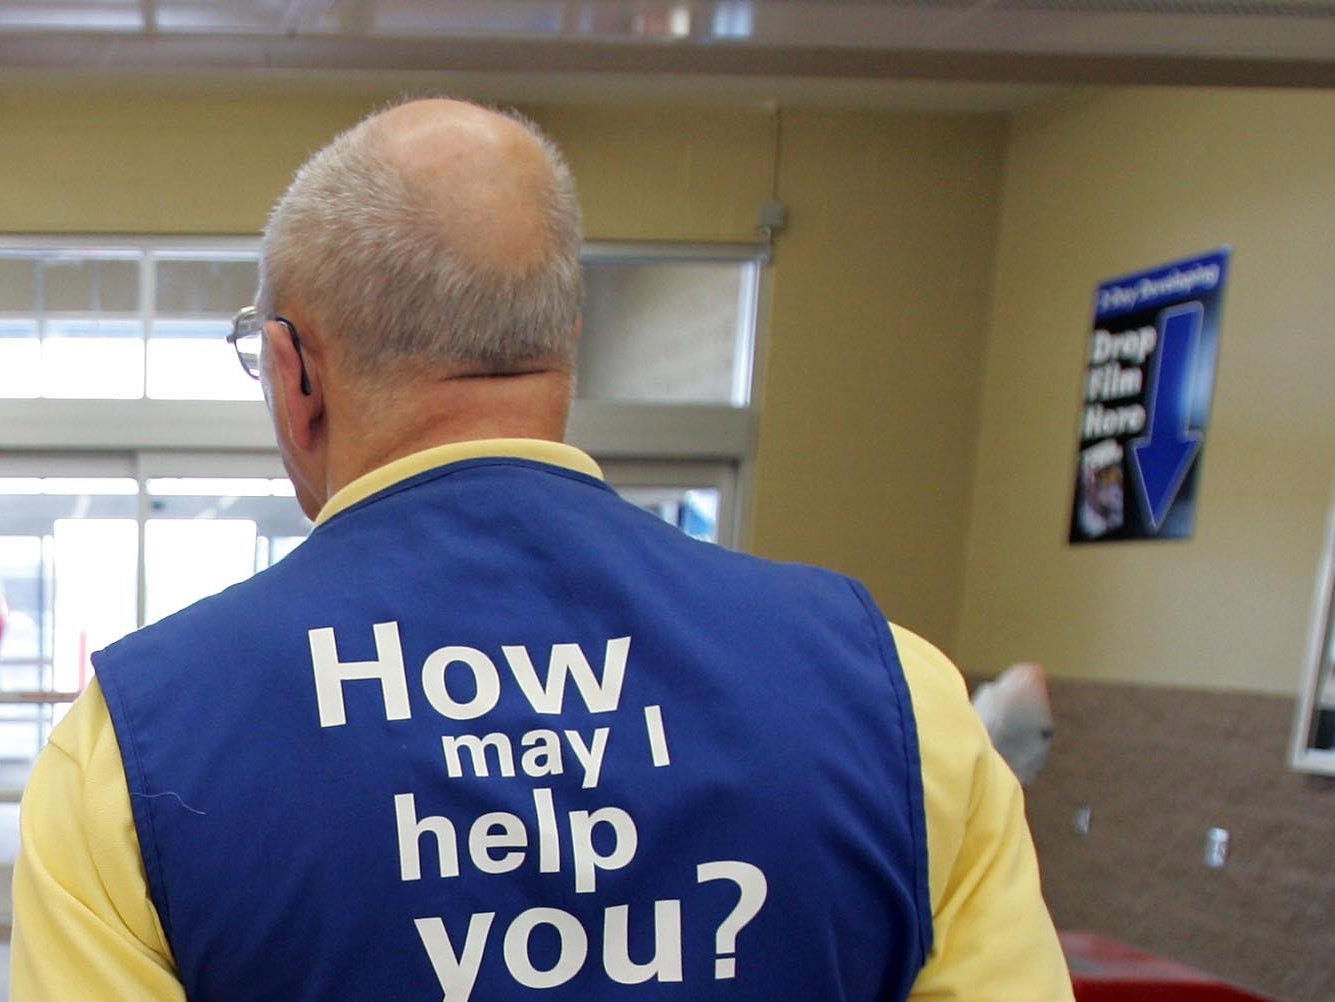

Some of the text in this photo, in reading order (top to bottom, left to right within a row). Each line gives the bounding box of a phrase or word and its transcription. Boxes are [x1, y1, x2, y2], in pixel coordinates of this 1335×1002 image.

[1092, 325, 1157, 365] Drop
[1087, 362, 1143, 401] Film
[1083, 403, 1146, 440] Here
[308, 621, 631, 727] How
[442, 705, 670, 788] may I
[394, 788, 638, 892] help
